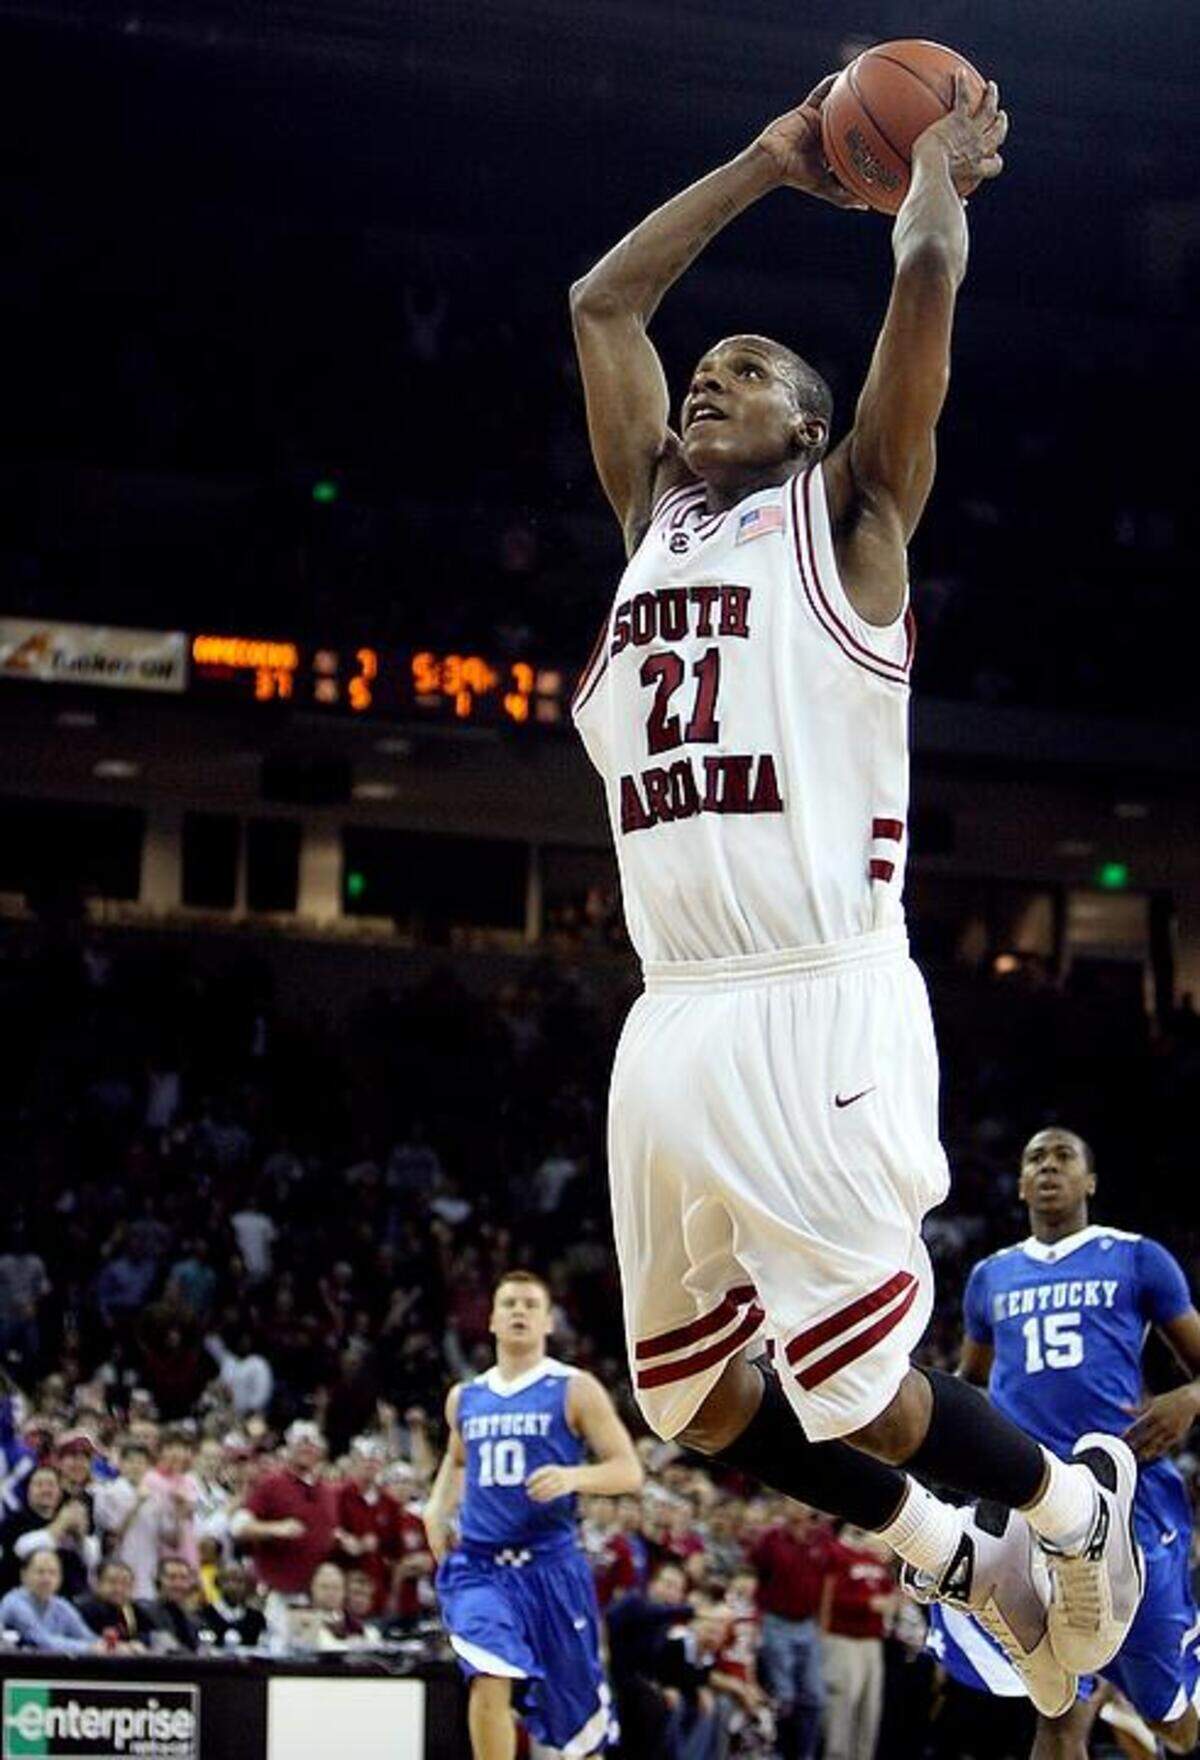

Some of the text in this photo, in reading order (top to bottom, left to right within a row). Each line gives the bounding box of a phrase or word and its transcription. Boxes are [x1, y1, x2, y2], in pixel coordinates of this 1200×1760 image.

[611, 584, 751, 657] SOUTH
[640, 646, 722, 756] 21
[620, 754, 783, 835] AROINA
[1022, 1312, 1084, 1375] 15
[478, 1438, 526, 1488] 10
[17, 1698, 195, 1751] enterprise
